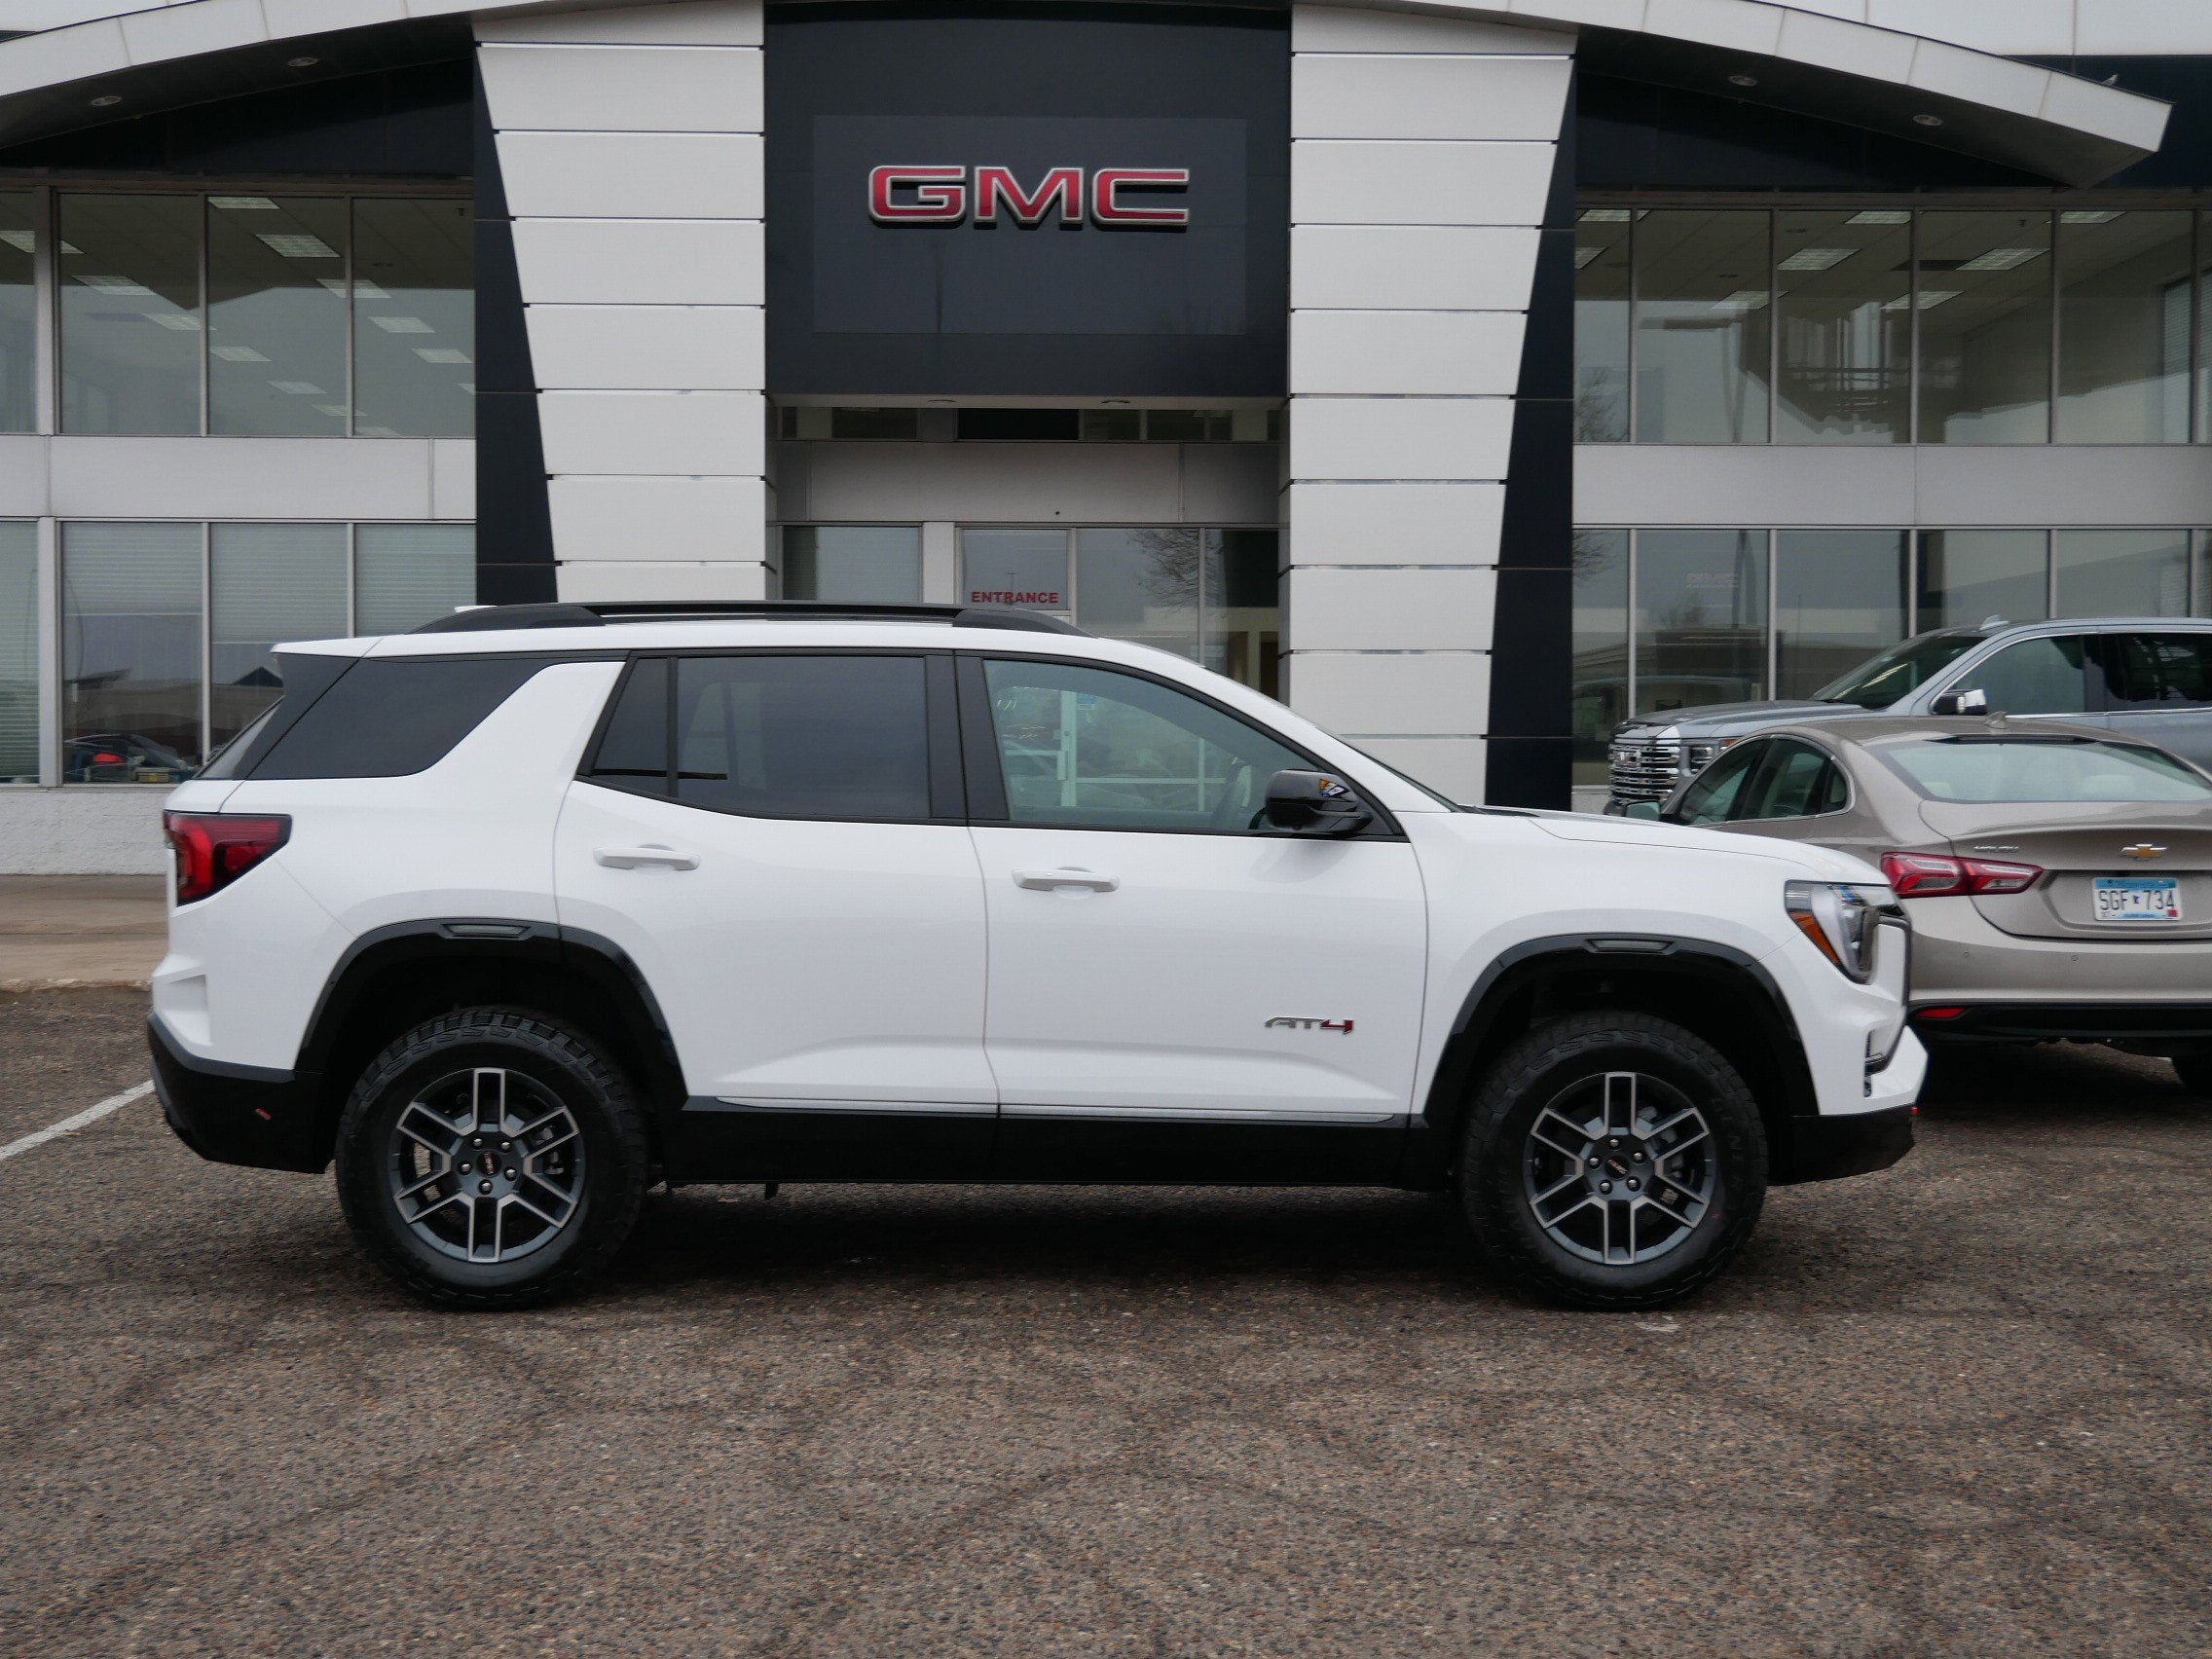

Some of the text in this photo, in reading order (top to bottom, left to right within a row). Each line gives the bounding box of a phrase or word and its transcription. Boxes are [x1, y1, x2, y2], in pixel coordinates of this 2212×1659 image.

[868, 166, 1190, 225] GMC
[971, 591, 1059, 604] ENTRANCE
[2098, 890, 2175, 910] SGF 734
[1265, 1016, 1354, 1034] AT4
